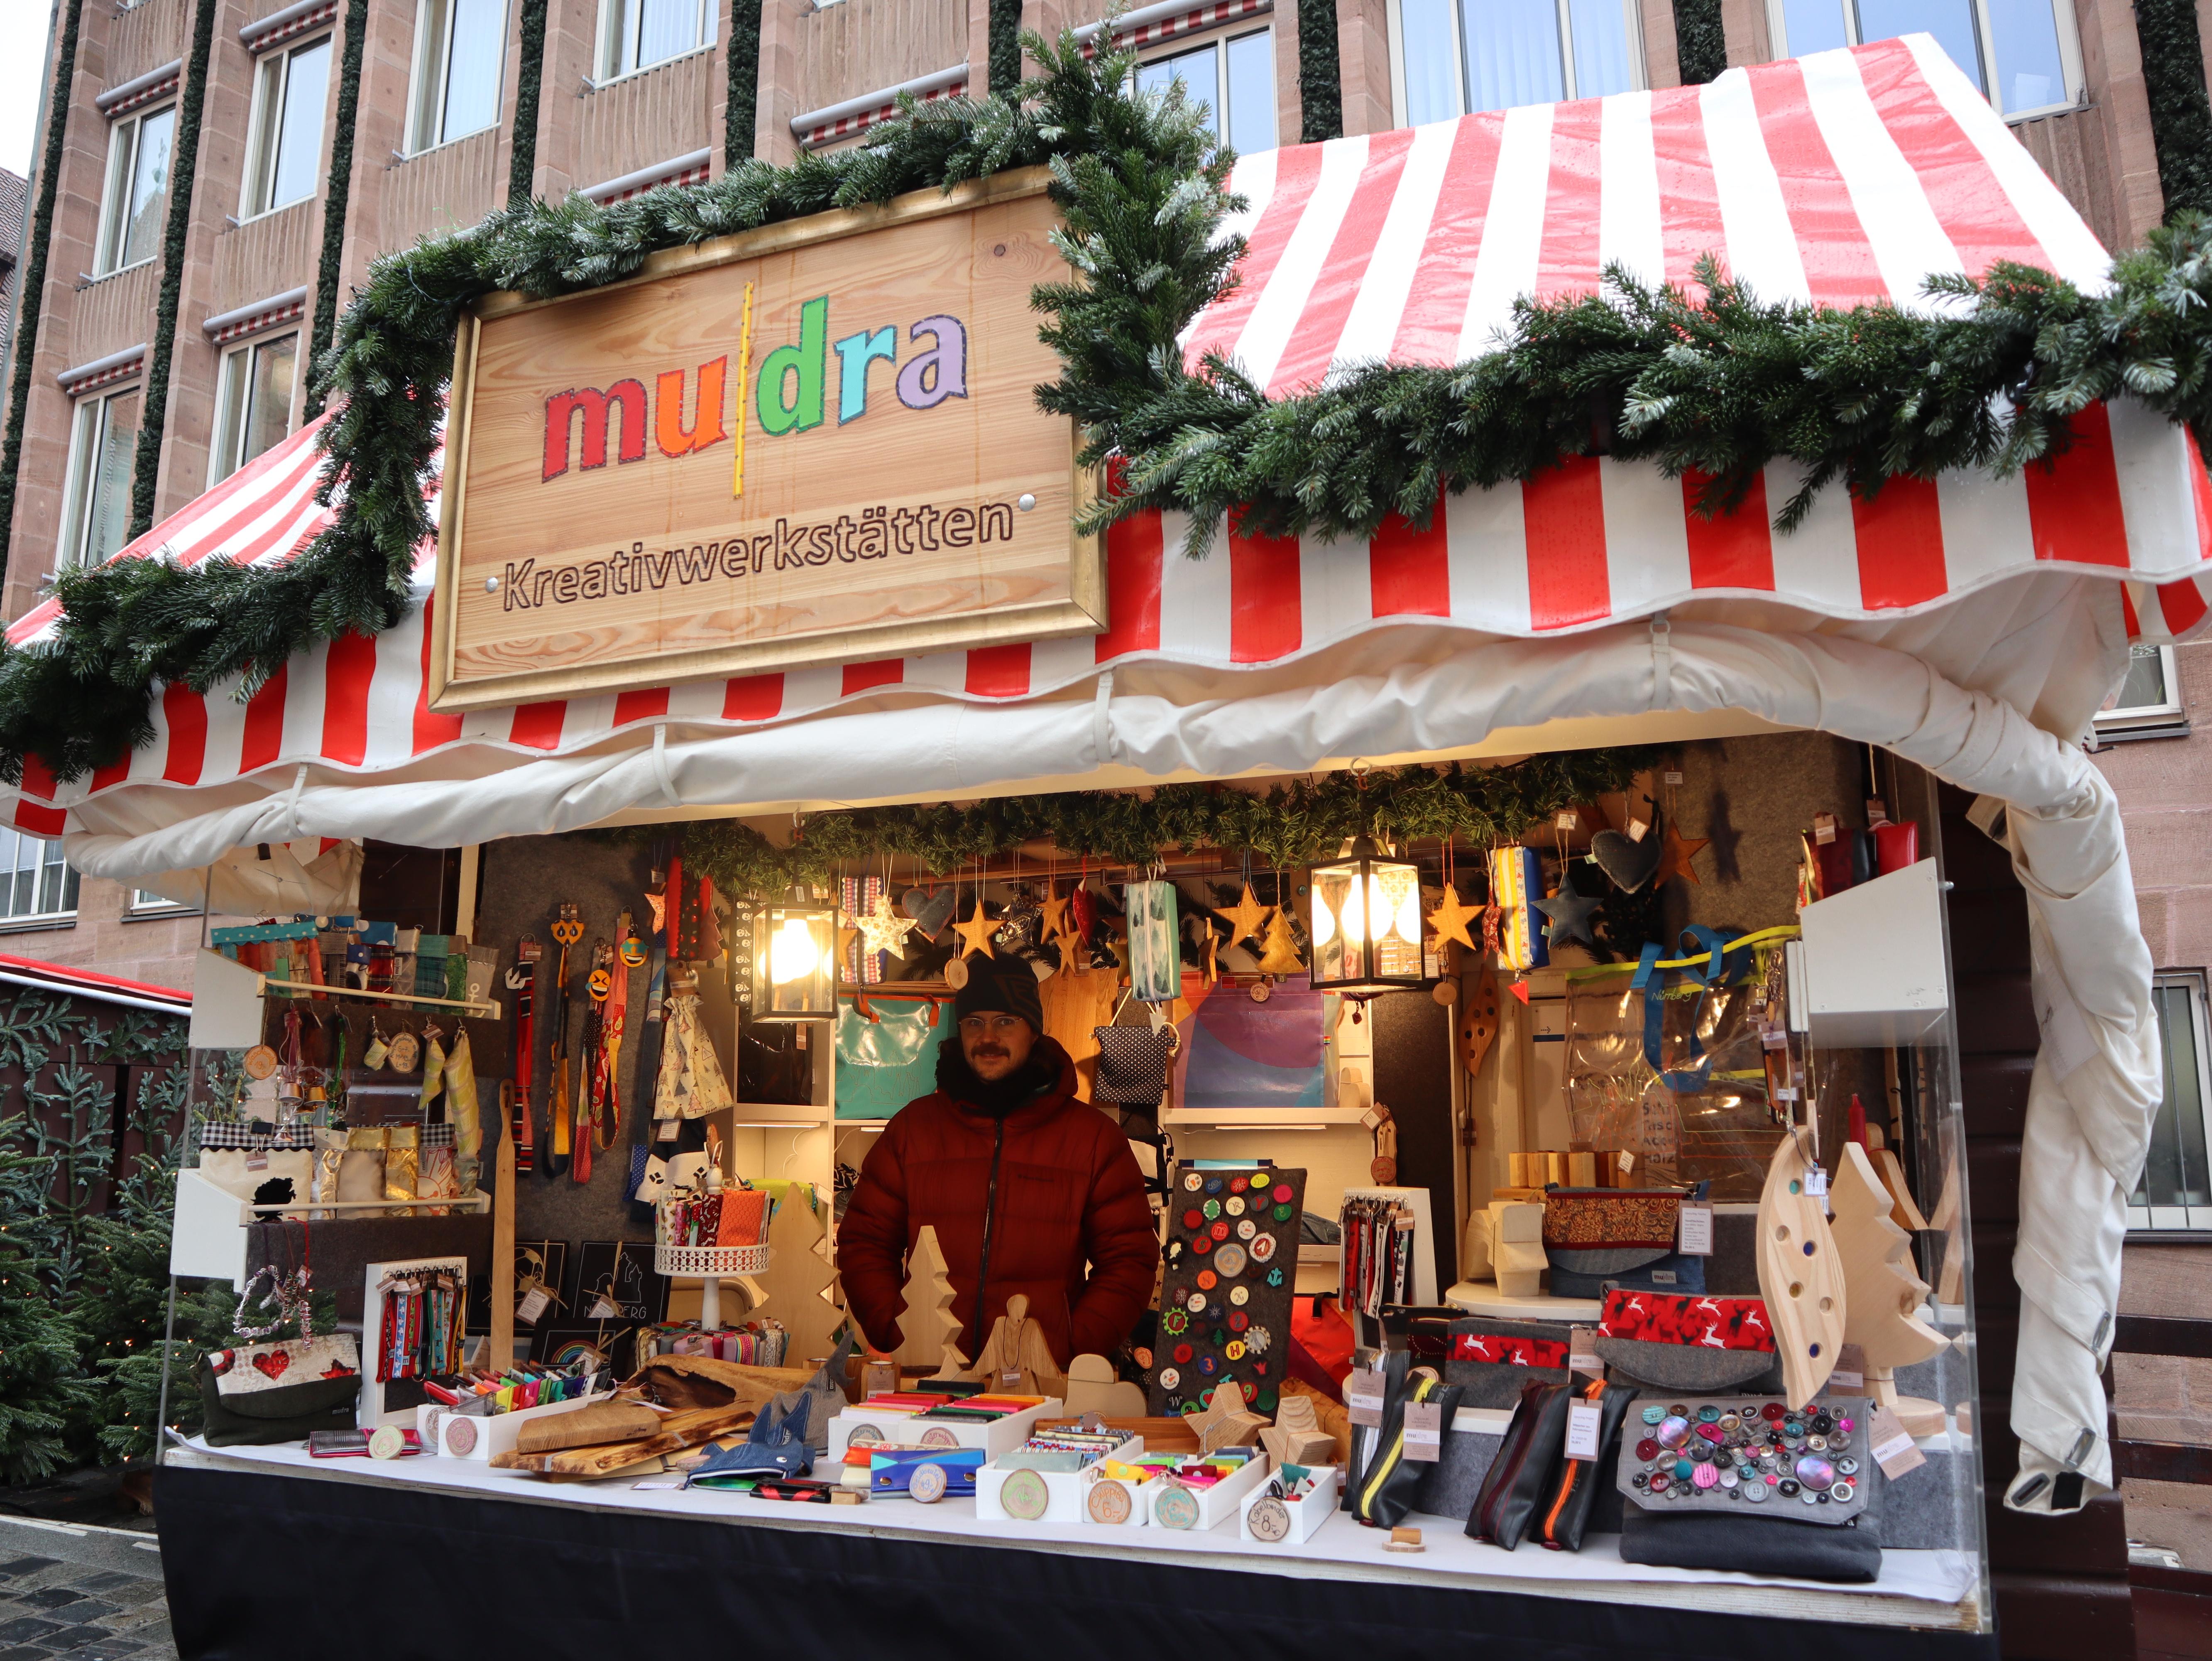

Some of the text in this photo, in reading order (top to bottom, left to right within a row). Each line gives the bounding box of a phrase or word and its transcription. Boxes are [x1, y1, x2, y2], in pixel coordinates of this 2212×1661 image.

[503, 501, 1014, 611] Kreativwerkstätten
[1651, 987, 1692, 1002] Nürnberg
[1255, 1196, 1265, 1210] Y
[1197, 1239, 1207, 1250] S
[1172, 1315, 1183, 1328] F
[1234, 1314, 1243, 1328] 2
[1230, 1344, 1240, 1358] H
[1204, 1357, 1214, 1372] 3
[1243, 1384, 1252, 1401] 9
[332, 1406, 349, 1415] mudra
[1091, 1487, 1127, 1508] Chippies
[1249, 1499, 1285, 1525] Kabelbinder
